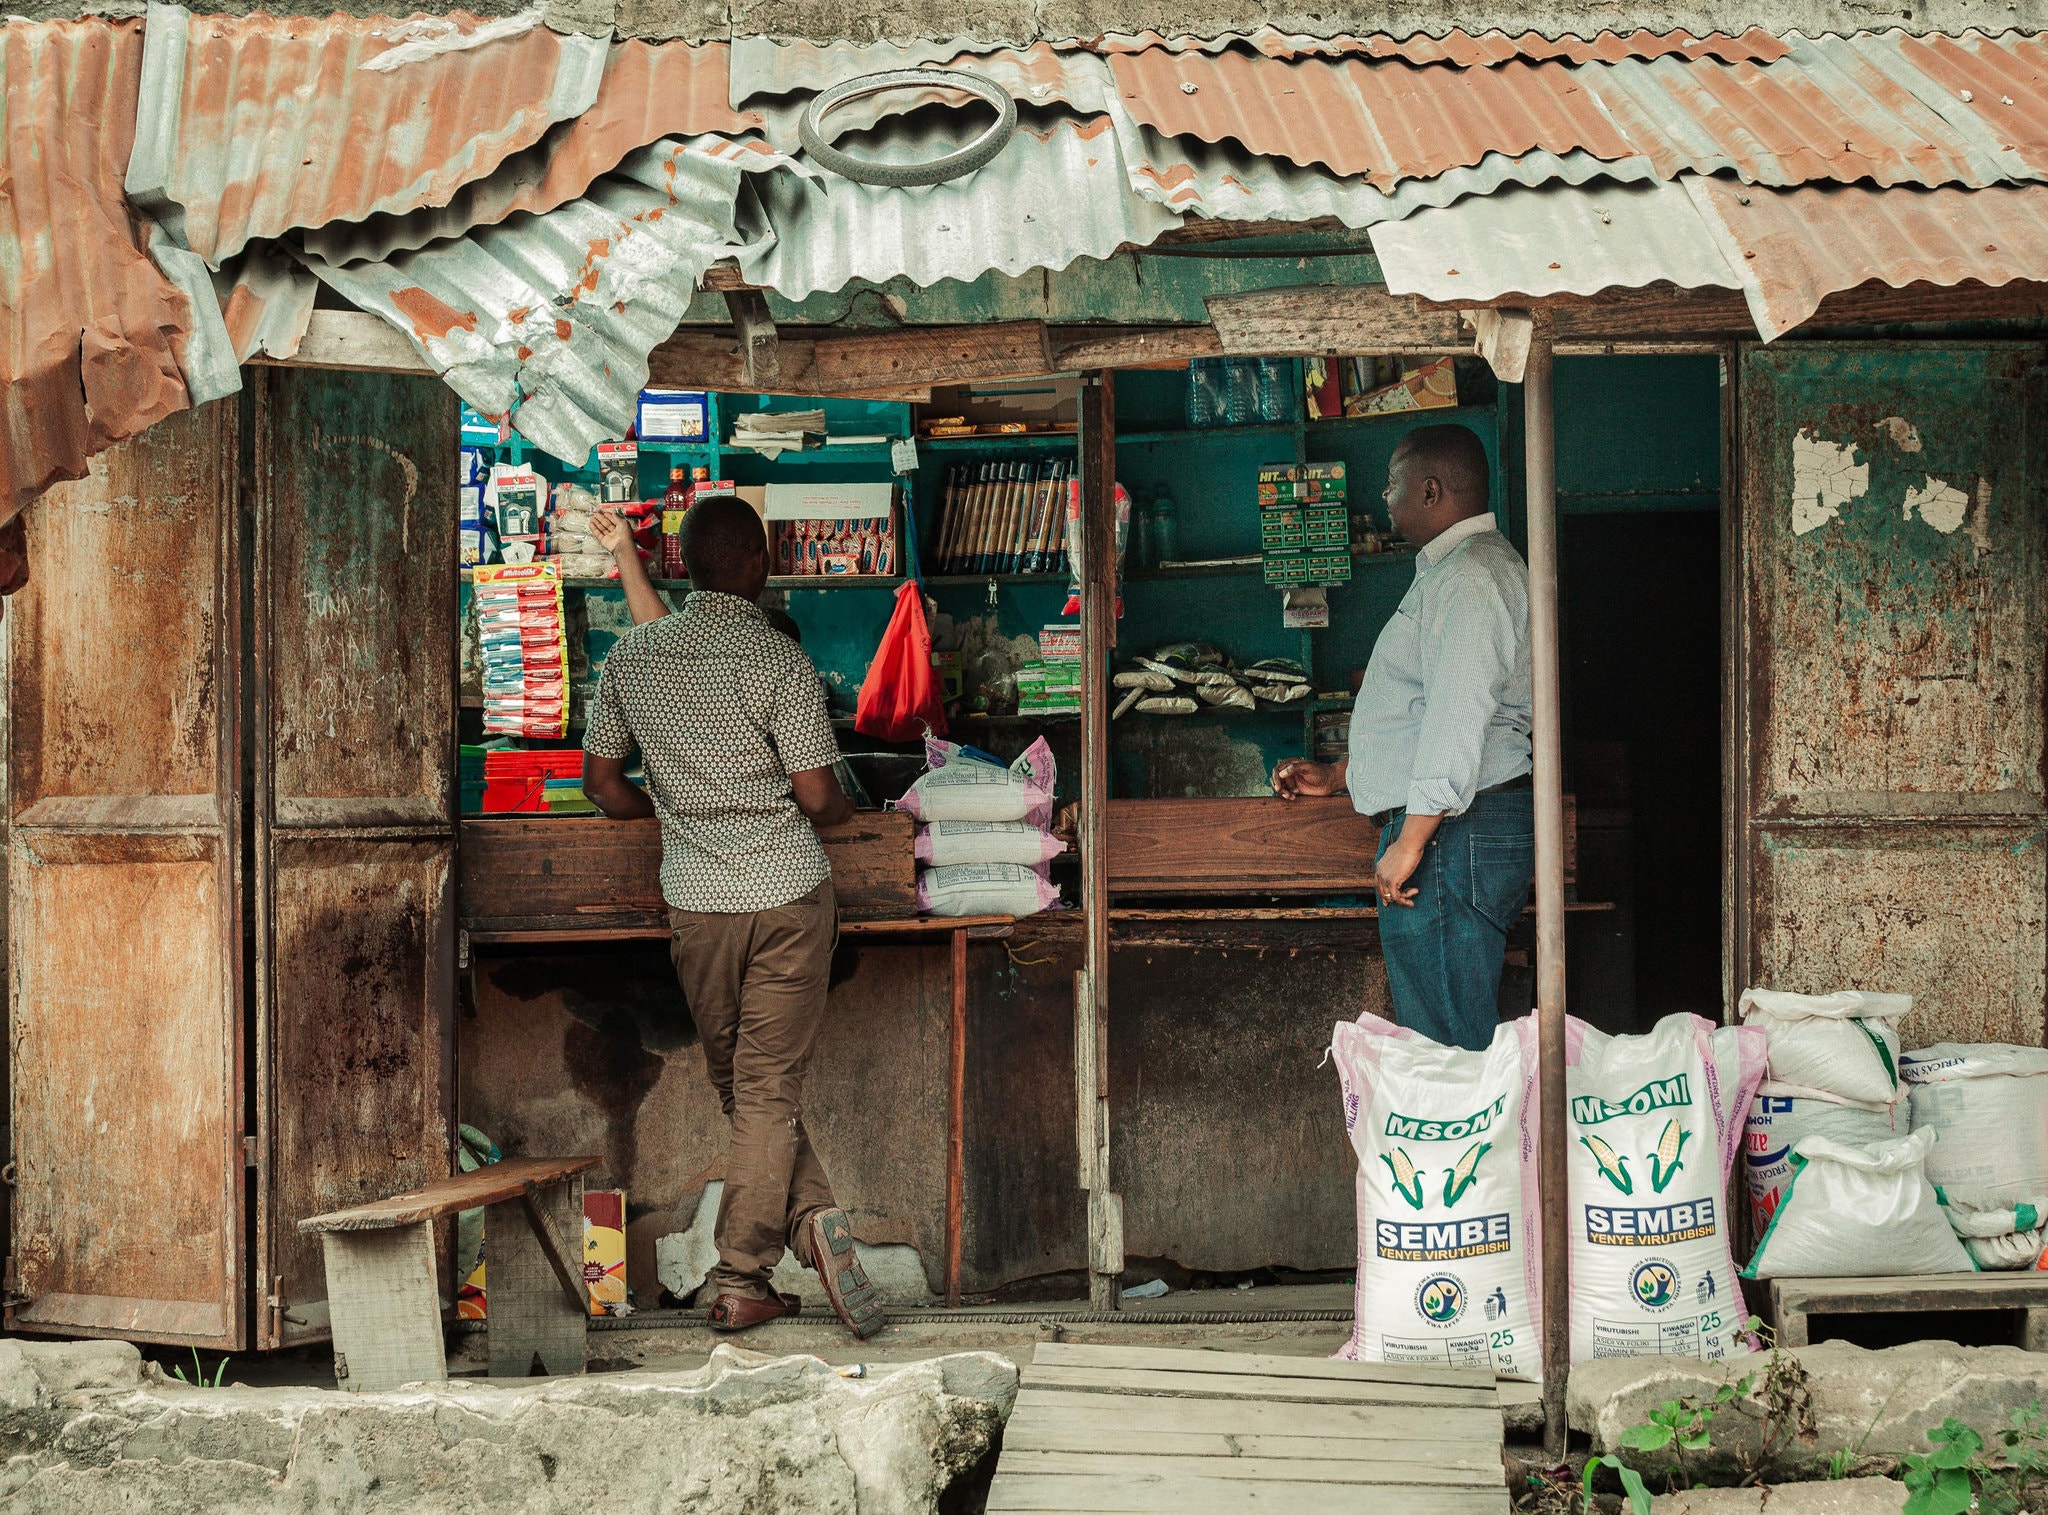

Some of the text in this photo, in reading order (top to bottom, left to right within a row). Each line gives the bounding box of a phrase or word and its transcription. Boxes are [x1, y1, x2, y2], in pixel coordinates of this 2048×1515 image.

[1921, 1057, 1966, 1076] AFRICA'S
[1574, 1076, 1690, 1123] MSOMI
[1346, 1094, 1360, 1130] MILLING
[1588, 1200, 1714, 1234] SEMBE
[1378, 1216, 1509, 1250] SEMBE
[1590, 1224, 1716, 1246] YENYE VIRUTUBISHI
[1379, 1241, 1510, 1261] YENYE VIRUTUBISHI
[1595, 1324, 1640, 1335] VIRUTUBISHI
[1662, 1321, 1695, 1333] KIWANGO
[1700, 1311, 1721, 1332] 25
[1384, 1341, 1428, 1351] VIRUTUBISHI
[1449, 1338, 1484, 1349] KIWANGO
[1490, 1328, 1515, 1349] 25
[1705, 1335, 1719, 1347] kg
[1497, 1353, 1513, 1365] kg
[1707, 1347, 1725, 1360] net
[1500, 1364, 1520, 1374] net
